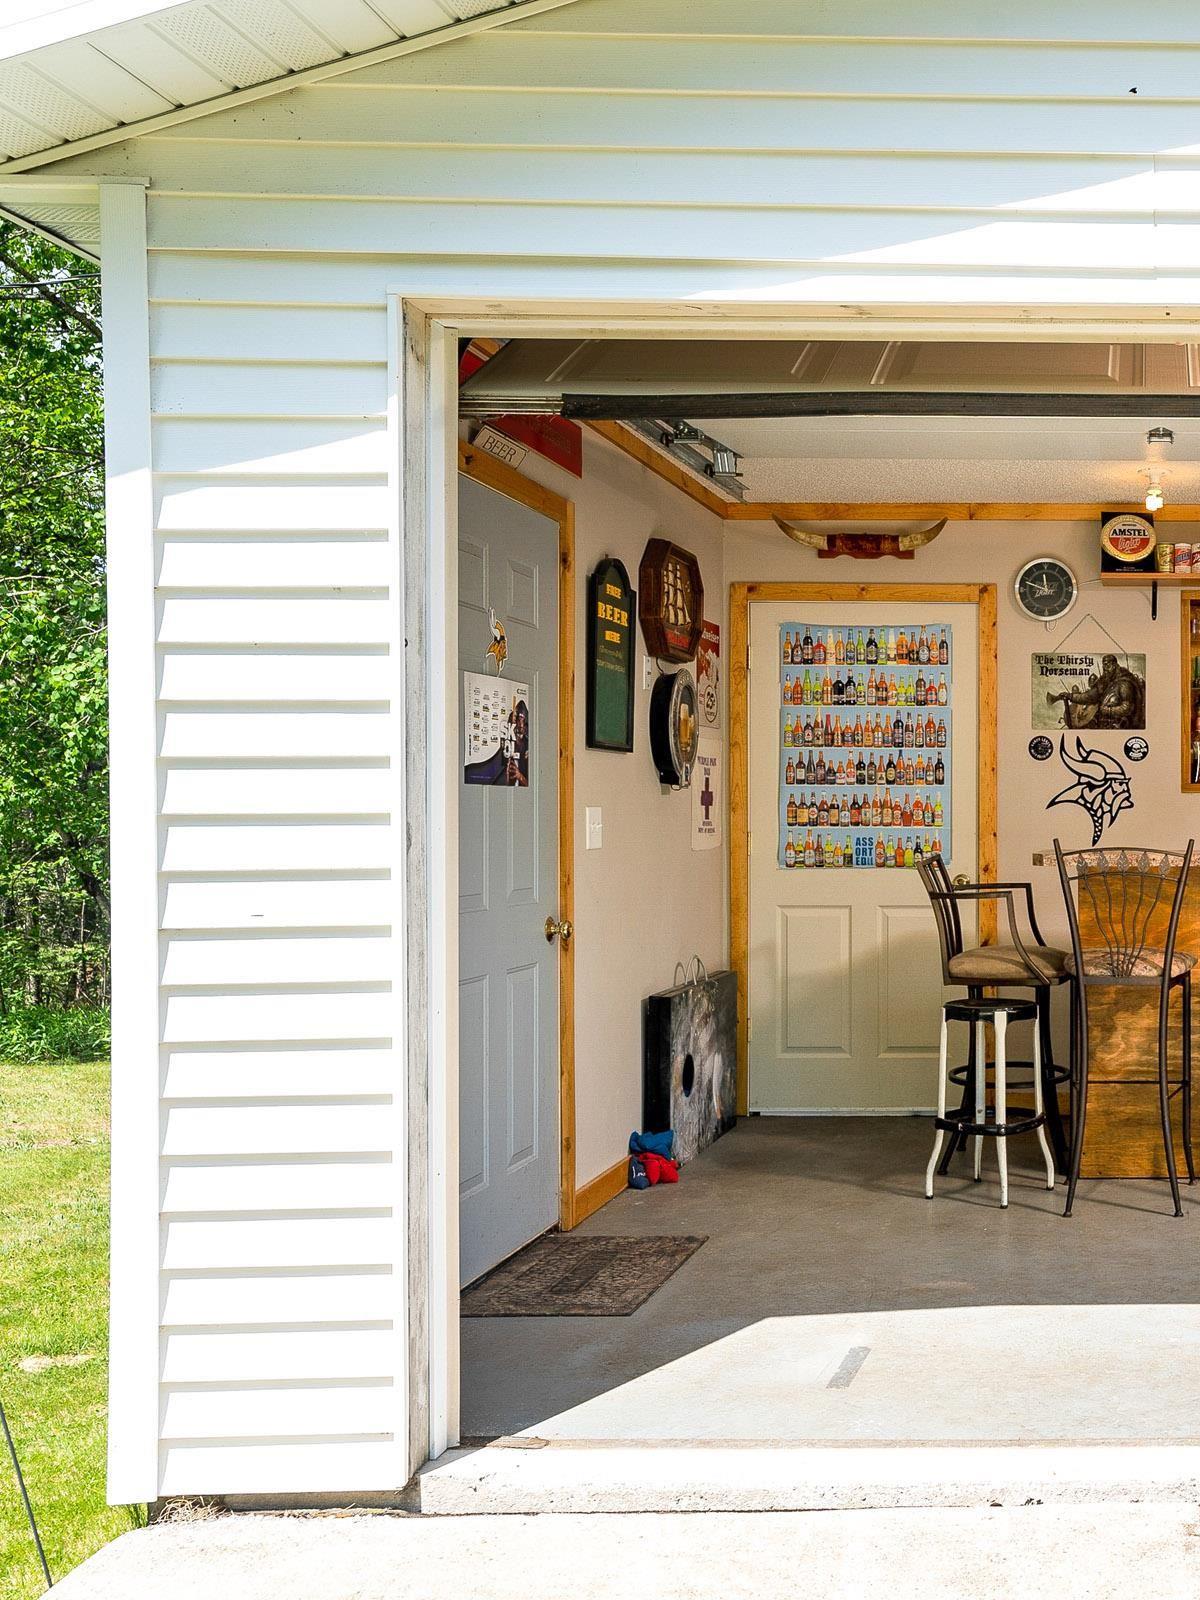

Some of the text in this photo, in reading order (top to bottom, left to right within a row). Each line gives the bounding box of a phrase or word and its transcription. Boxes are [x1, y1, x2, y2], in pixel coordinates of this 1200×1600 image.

[482, 435, 517, 462] BEER
[1111, 528, 1148, 537] AMSTEL
[606, 583, 622, 600] FREE
[597, 600, 629, 627] BEER
[1035, 655, 1094, 667] The Thirsty
[1039, 666, 1090, 677] Norseman
[855, 836, 874, 847] ASS
[855, 847, 874, 857] ORT
